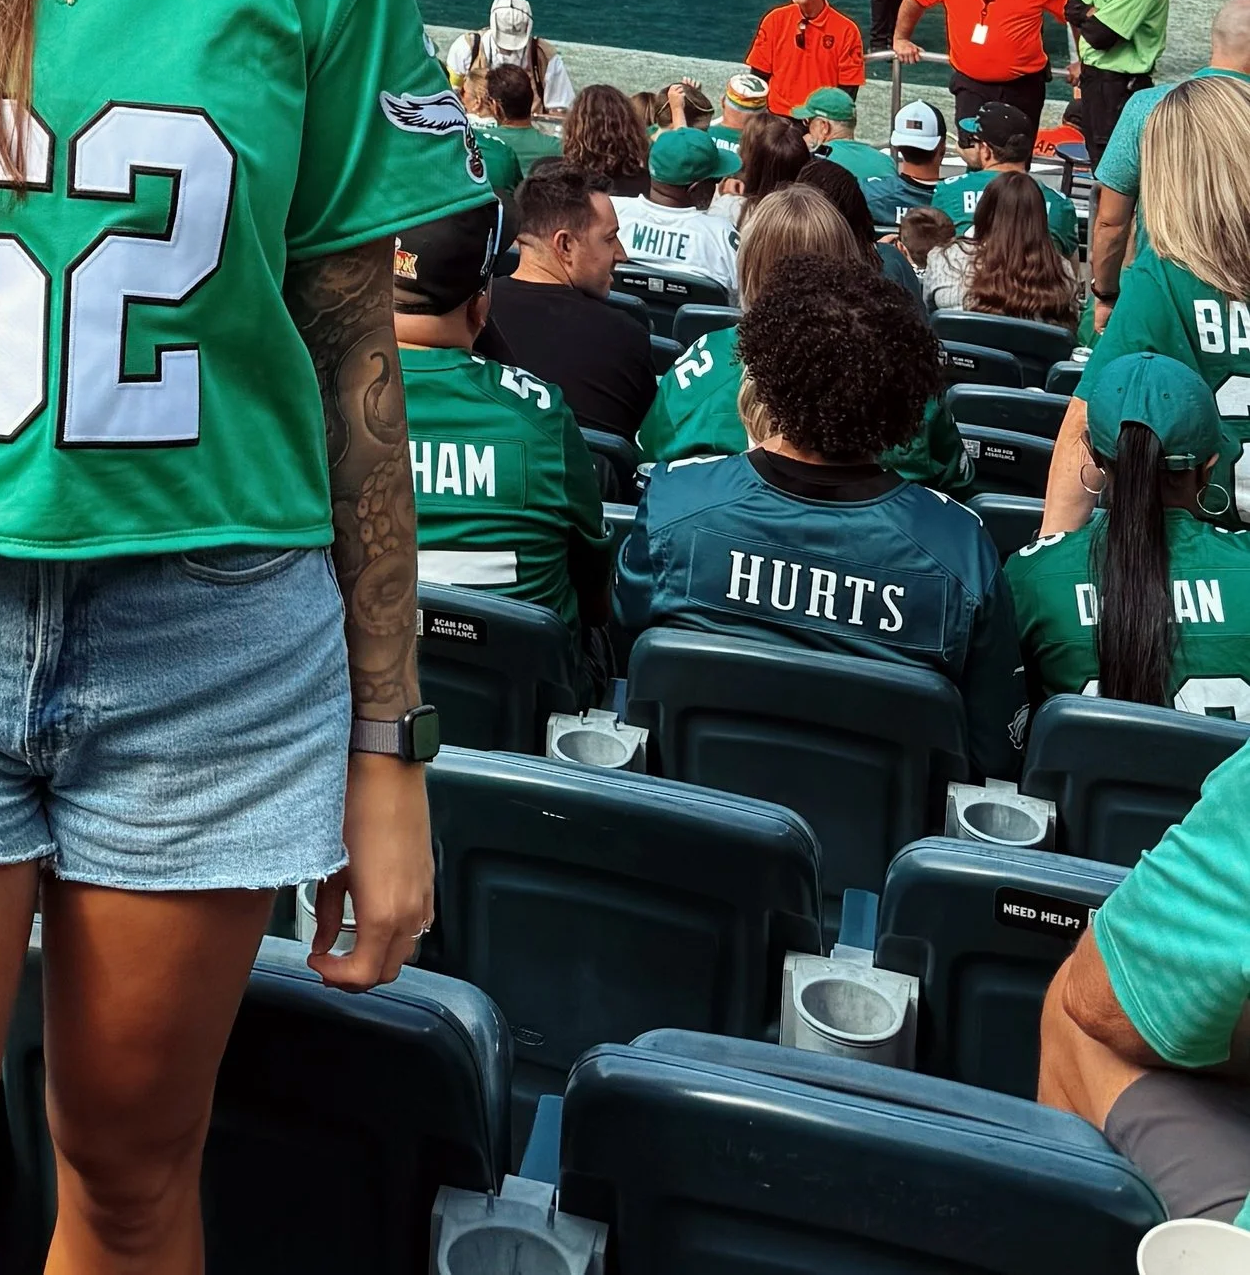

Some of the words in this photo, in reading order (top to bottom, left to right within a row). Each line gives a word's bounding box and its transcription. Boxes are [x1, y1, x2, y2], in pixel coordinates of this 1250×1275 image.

[633, 222, 690, 260] WHITE
[725, 550, 905, 633] HURTS
[431, 625, 477, 640] ASSISTANCE
[434, 618, 456, 628] SCAN
[458, 622, 474, 632] FOR
[1003, 903, 1036, 920] NEED
[1041, 911, 1081, 930] HELP?
